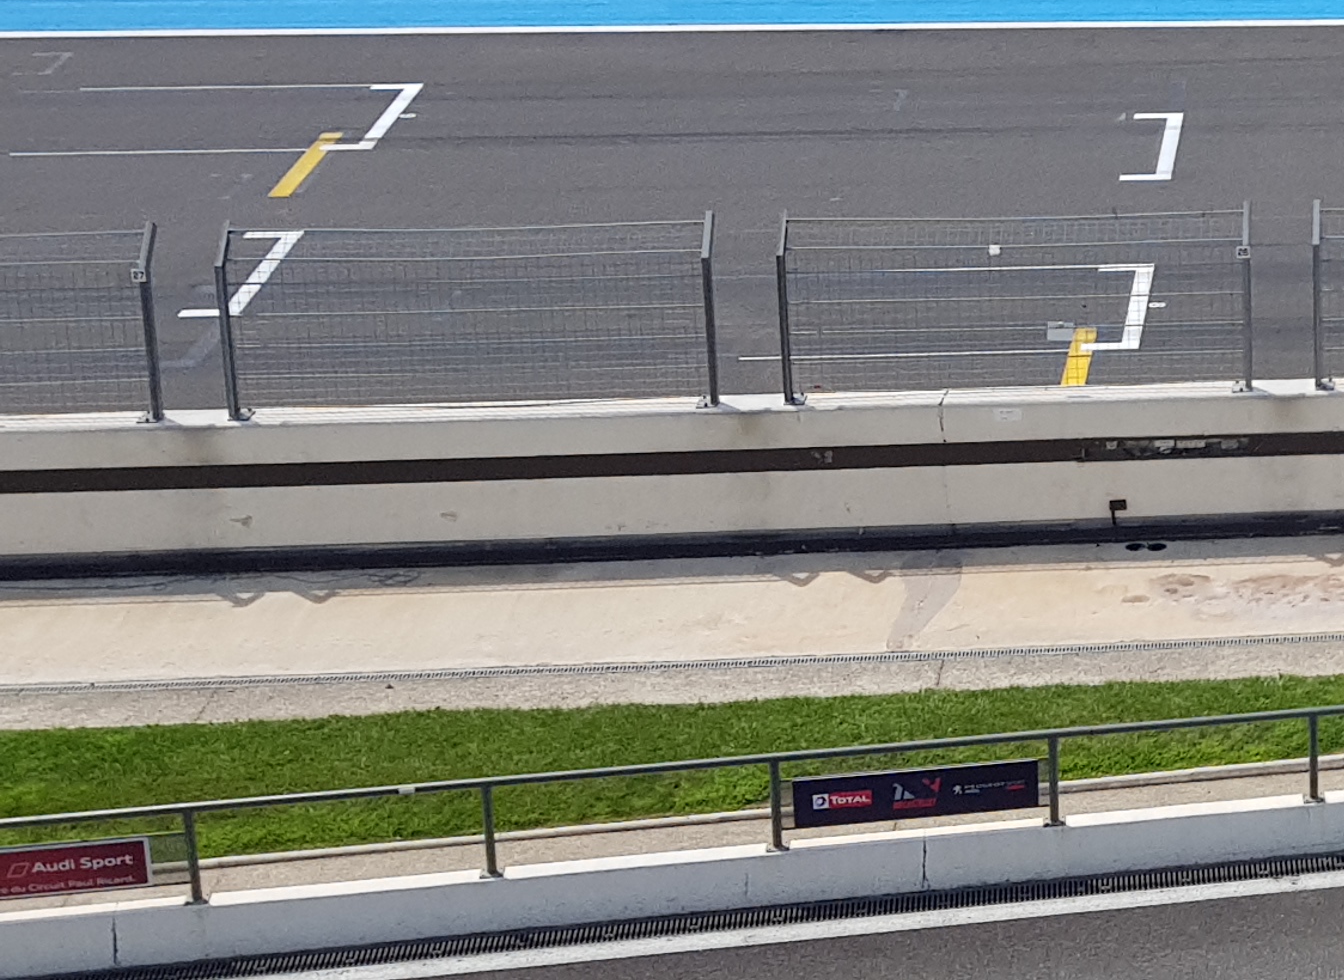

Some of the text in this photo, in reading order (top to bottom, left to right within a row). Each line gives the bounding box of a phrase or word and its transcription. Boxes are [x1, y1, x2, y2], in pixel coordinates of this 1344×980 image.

[830, 793, 870, 805] TOTAL
[32, 854, 133, 873] Audi Sport
